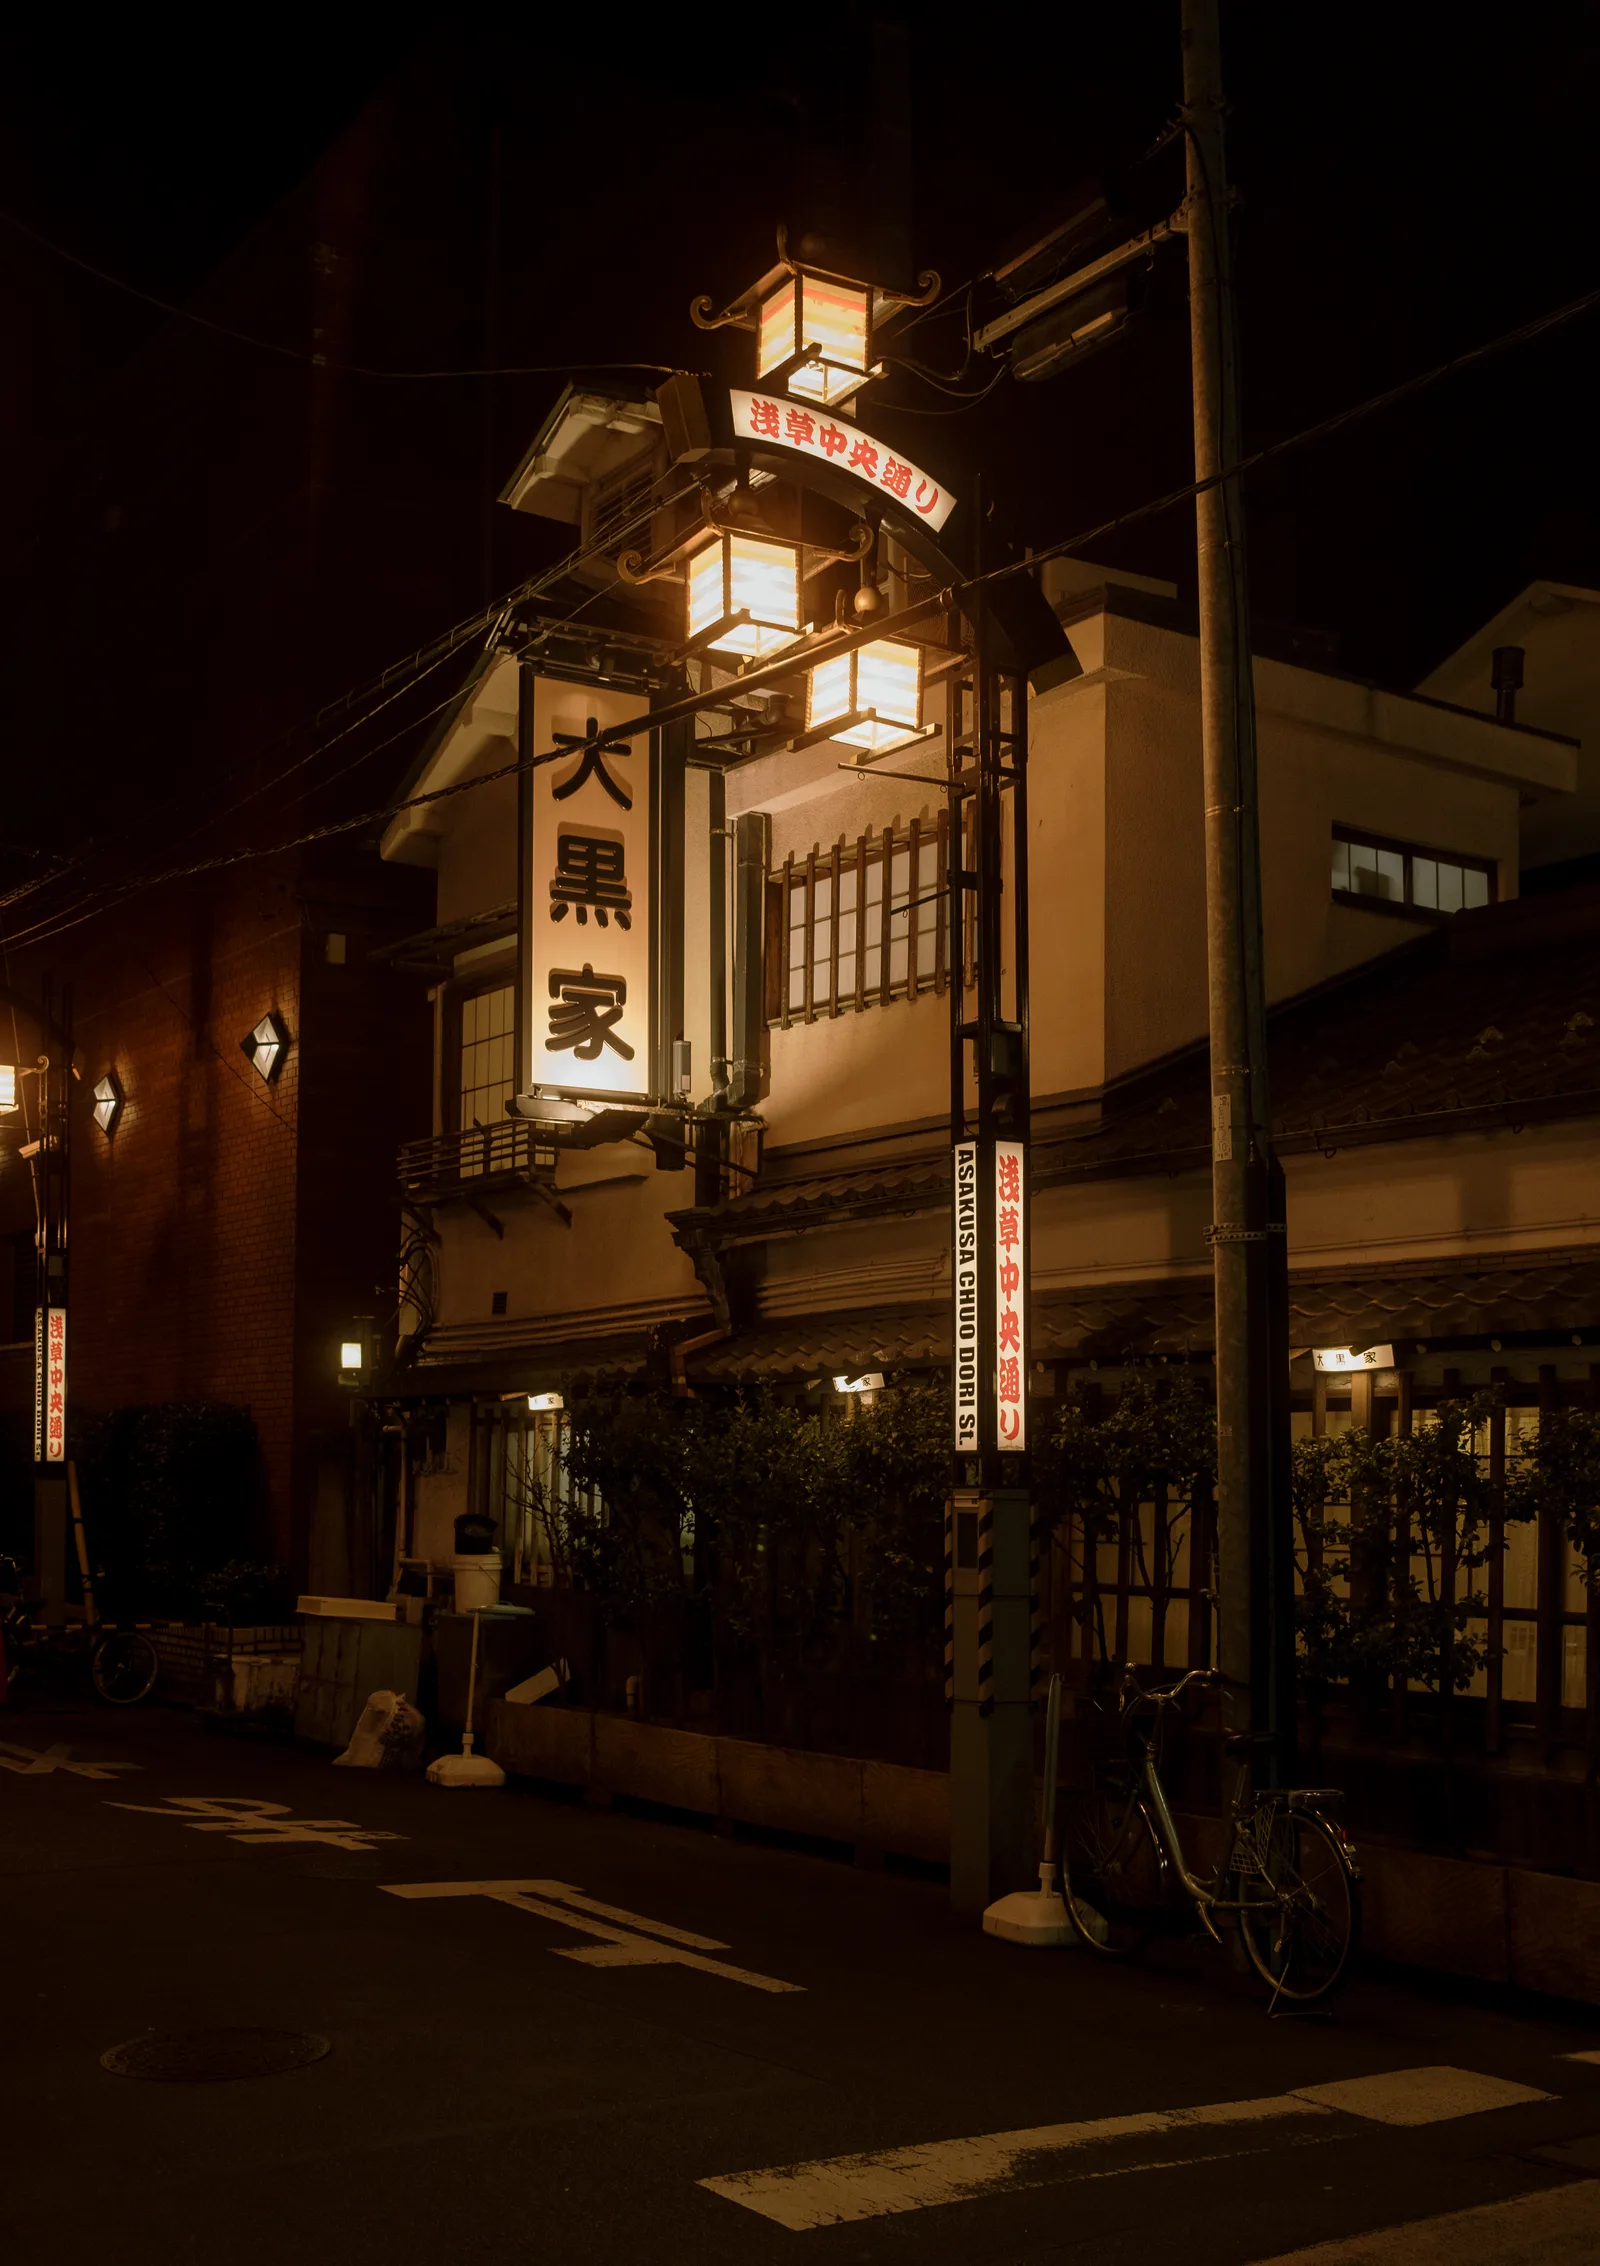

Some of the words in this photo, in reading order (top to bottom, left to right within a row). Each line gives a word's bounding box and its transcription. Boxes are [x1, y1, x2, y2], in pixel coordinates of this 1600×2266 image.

[750, 397, 939, 515] 浅草中央通り
[545, 716, 635, 1061] 大黒家
[958, 1149, 975, 1265] ASAKUSA
[959, 1271, 976, 1339] CHUO
[998, 1154, 1021, 1441] 浅草中央通り
[49, 1315, 63, 1458] 浅草中央通り
[959, 1346, 976, 1407] DORI
[1316, 1351, 1377, 1366] 大黒家
